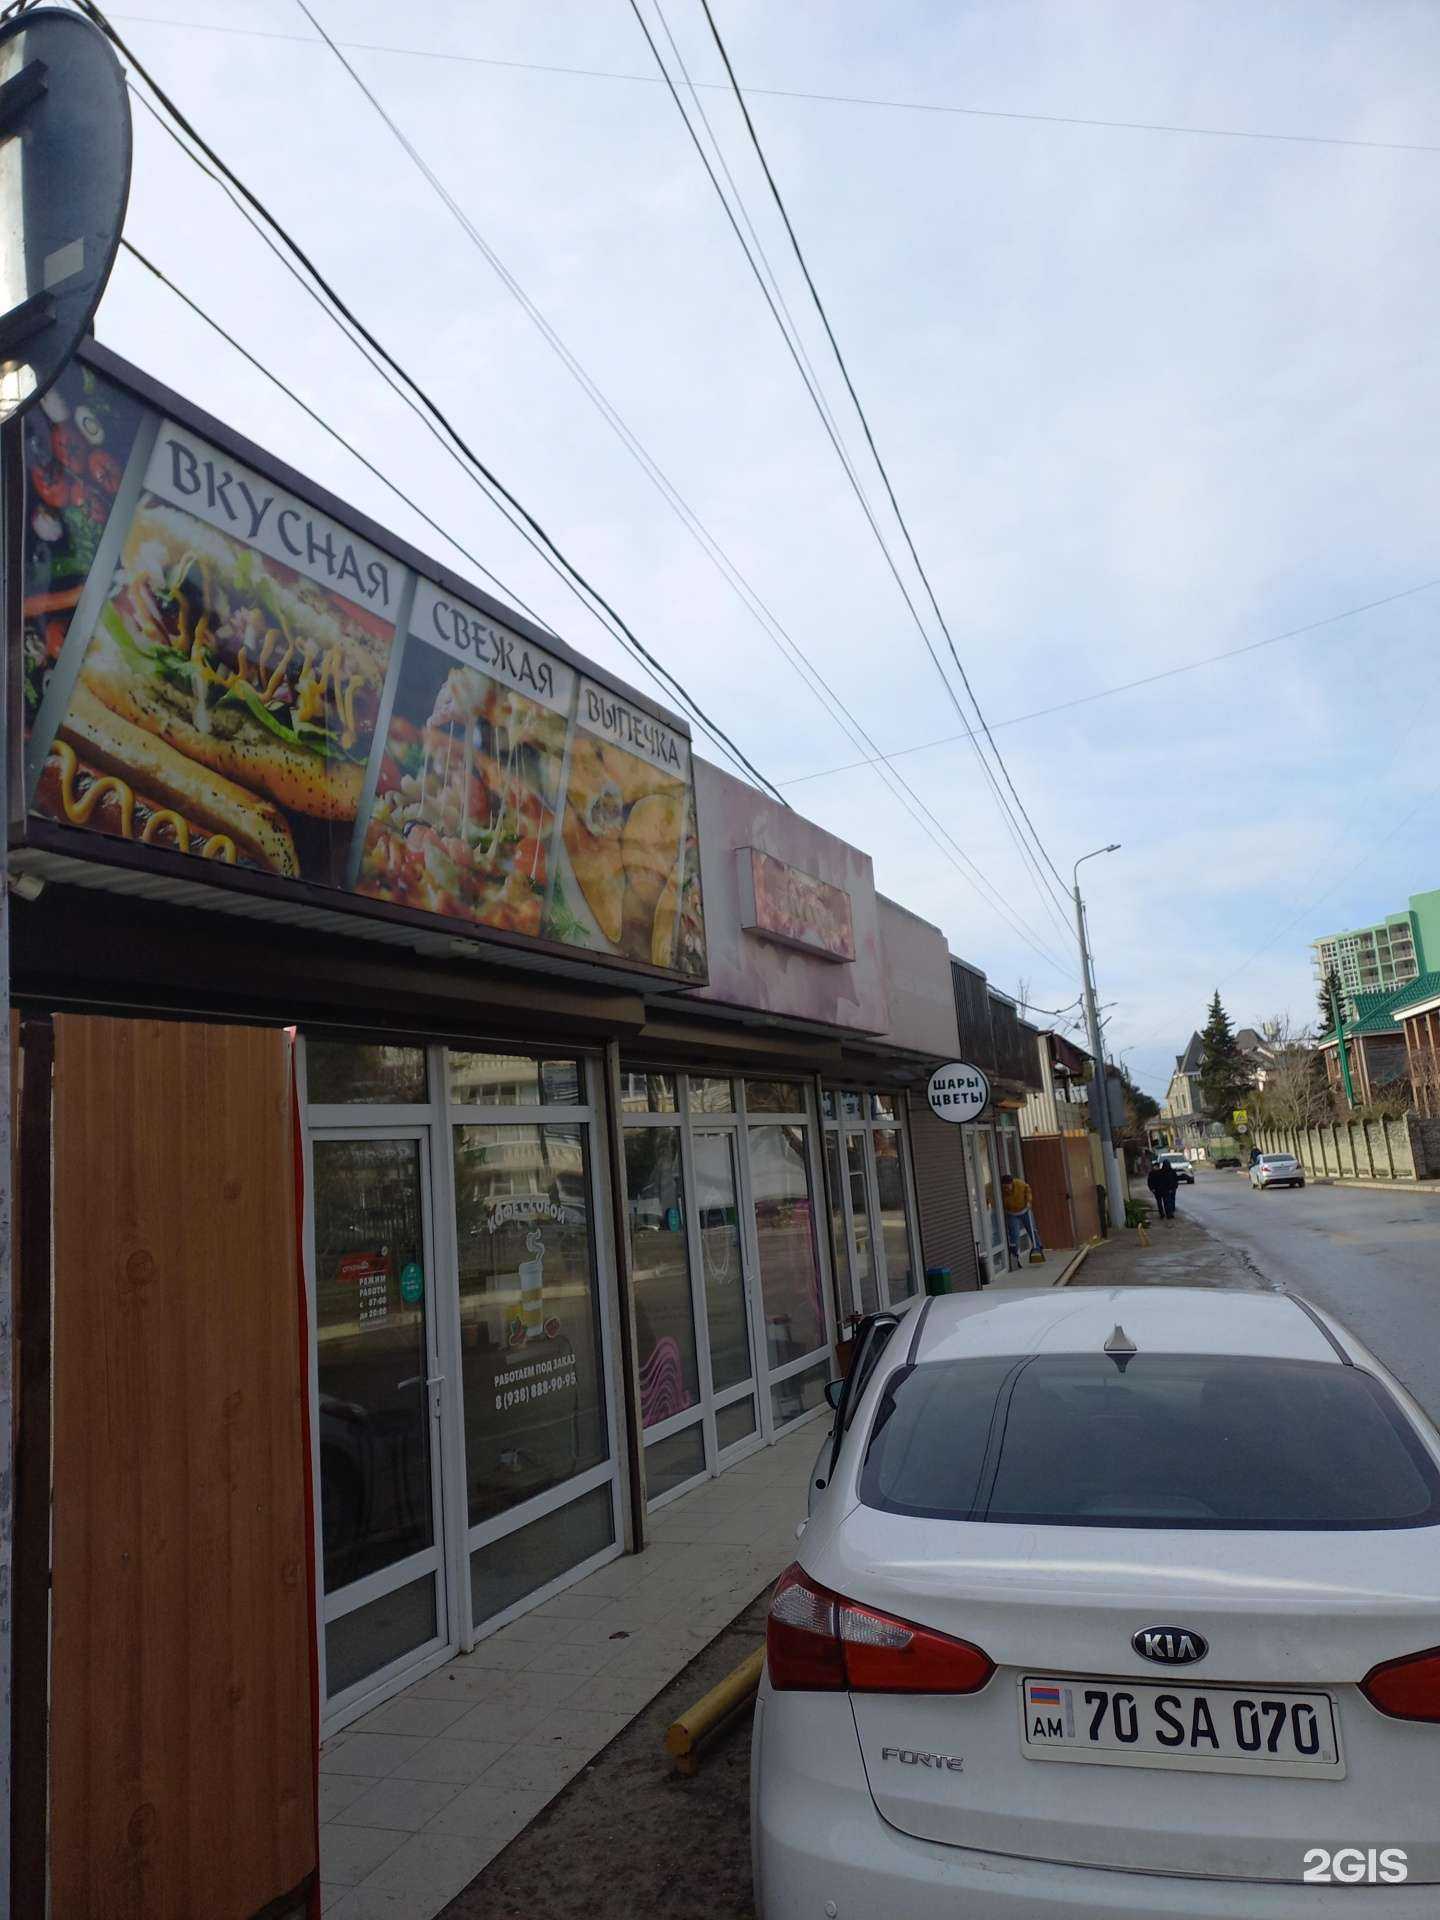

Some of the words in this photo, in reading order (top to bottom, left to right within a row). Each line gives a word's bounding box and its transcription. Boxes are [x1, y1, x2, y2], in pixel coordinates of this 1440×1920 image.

[166, 439, 389, 606] ВКУСНАЯ
[432, 601, 554, 699] СВЕЖАЯ
[585, 687, 681, 770] ВЫПЕЧКА
[933, 1077, 979, 1090] ШАРЫ
[931, 1092, 983, 1107] ЦВЕТЫ
[494, 1364, 535, 1388] РАБОТАЕМ
[535, 1360, 553, 1376] ПОД
[553, 1353, 577, 1370] ЗАКАЗ
[495, 1394, 502, 1410] 8
[503, 1385, 529, 1411] (938)
[1144, 1633, 1198, 1658] KIA
[1032, 1716, 1064, 1738] AM
[1085, 1690, 1139, 1743] 70
[1155, 1694, 1220, 1749] SA
[1233, 1699, 1320, 1755] 070
[882, 1746, 964, 1772] FORTE
